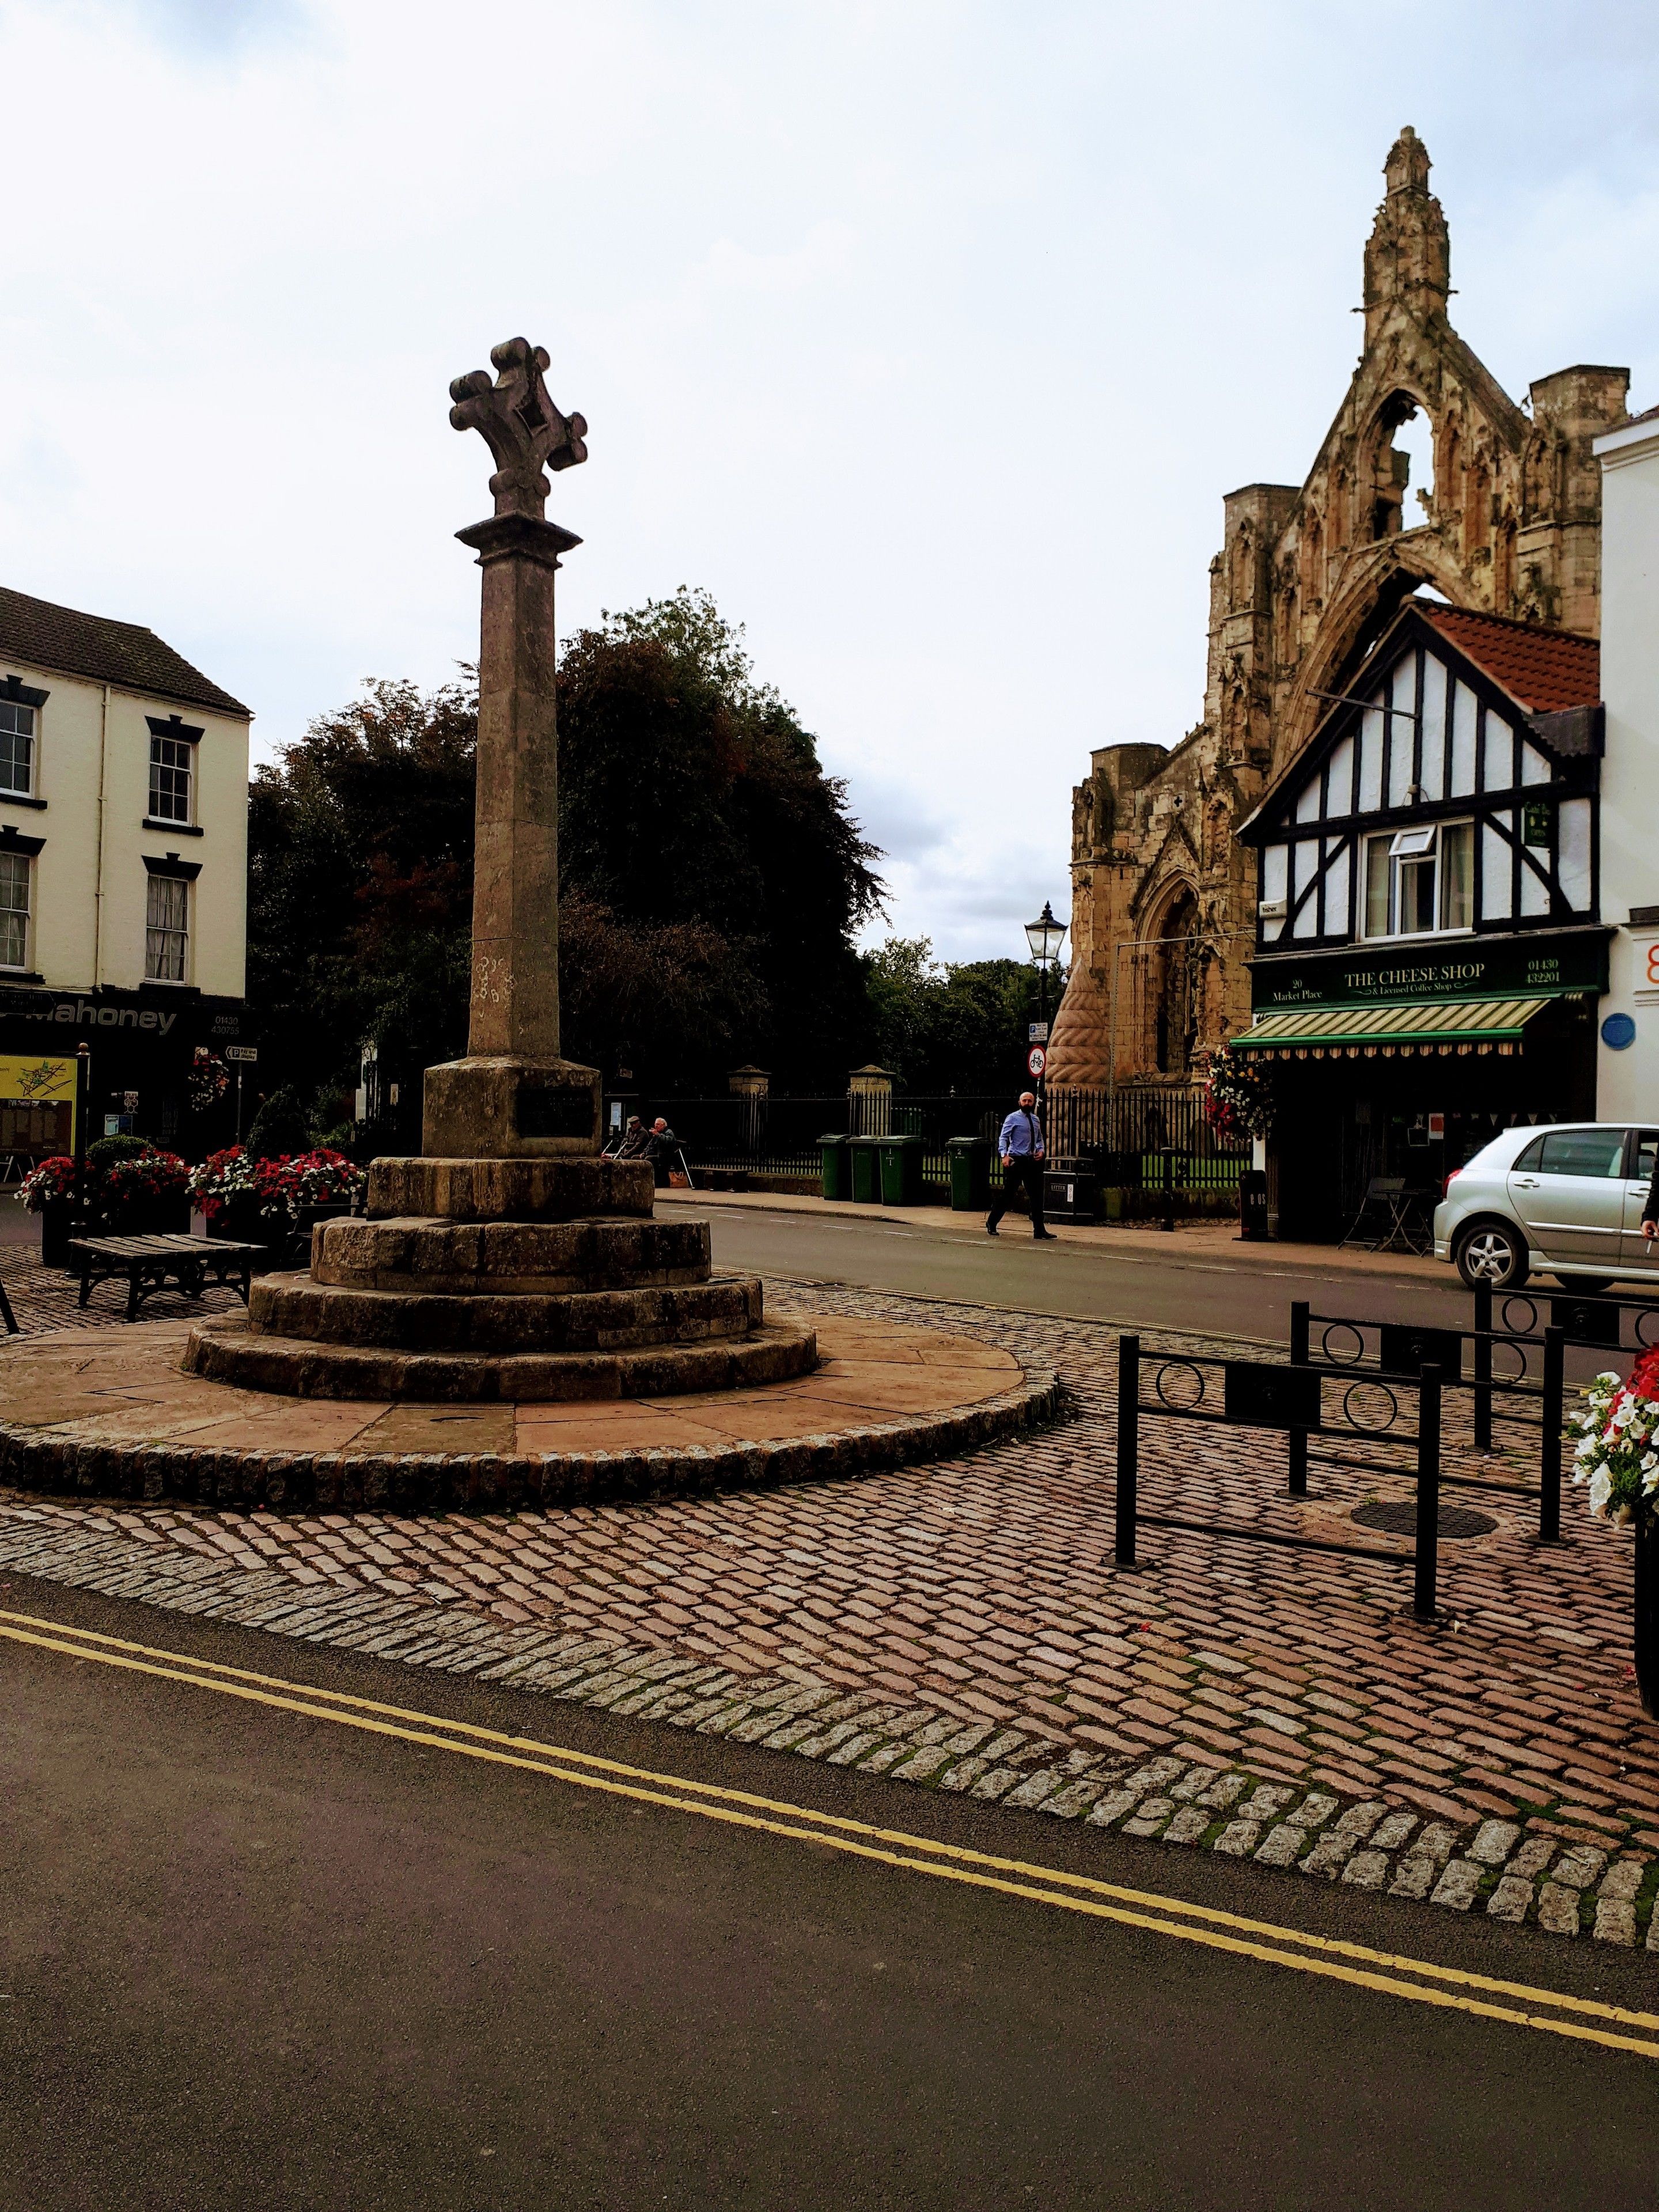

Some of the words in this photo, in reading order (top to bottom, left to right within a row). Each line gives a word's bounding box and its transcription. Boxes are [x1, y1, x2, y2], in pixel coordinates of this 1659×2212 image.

[1528, 959, 1559, 970] 01430
[1344, 972, 1376, 987] THE
[1379, 967, 1437, 984] CHEESE
[1441, 963, 1485, 980] SHOP
[1292, 980, 1302, 989] 20
[1372, 987, 1378, 995] &
[1380, 984, 1409, 995] Licensed
[1410, 983, 1433, 993] Coffee
[1434, 982, 1452, 991] Shop
[1273, 991, 1300, 1002] Market
[1302, 989, 1323, 999] Place
[215, 1016, 238, 1025] 01430
